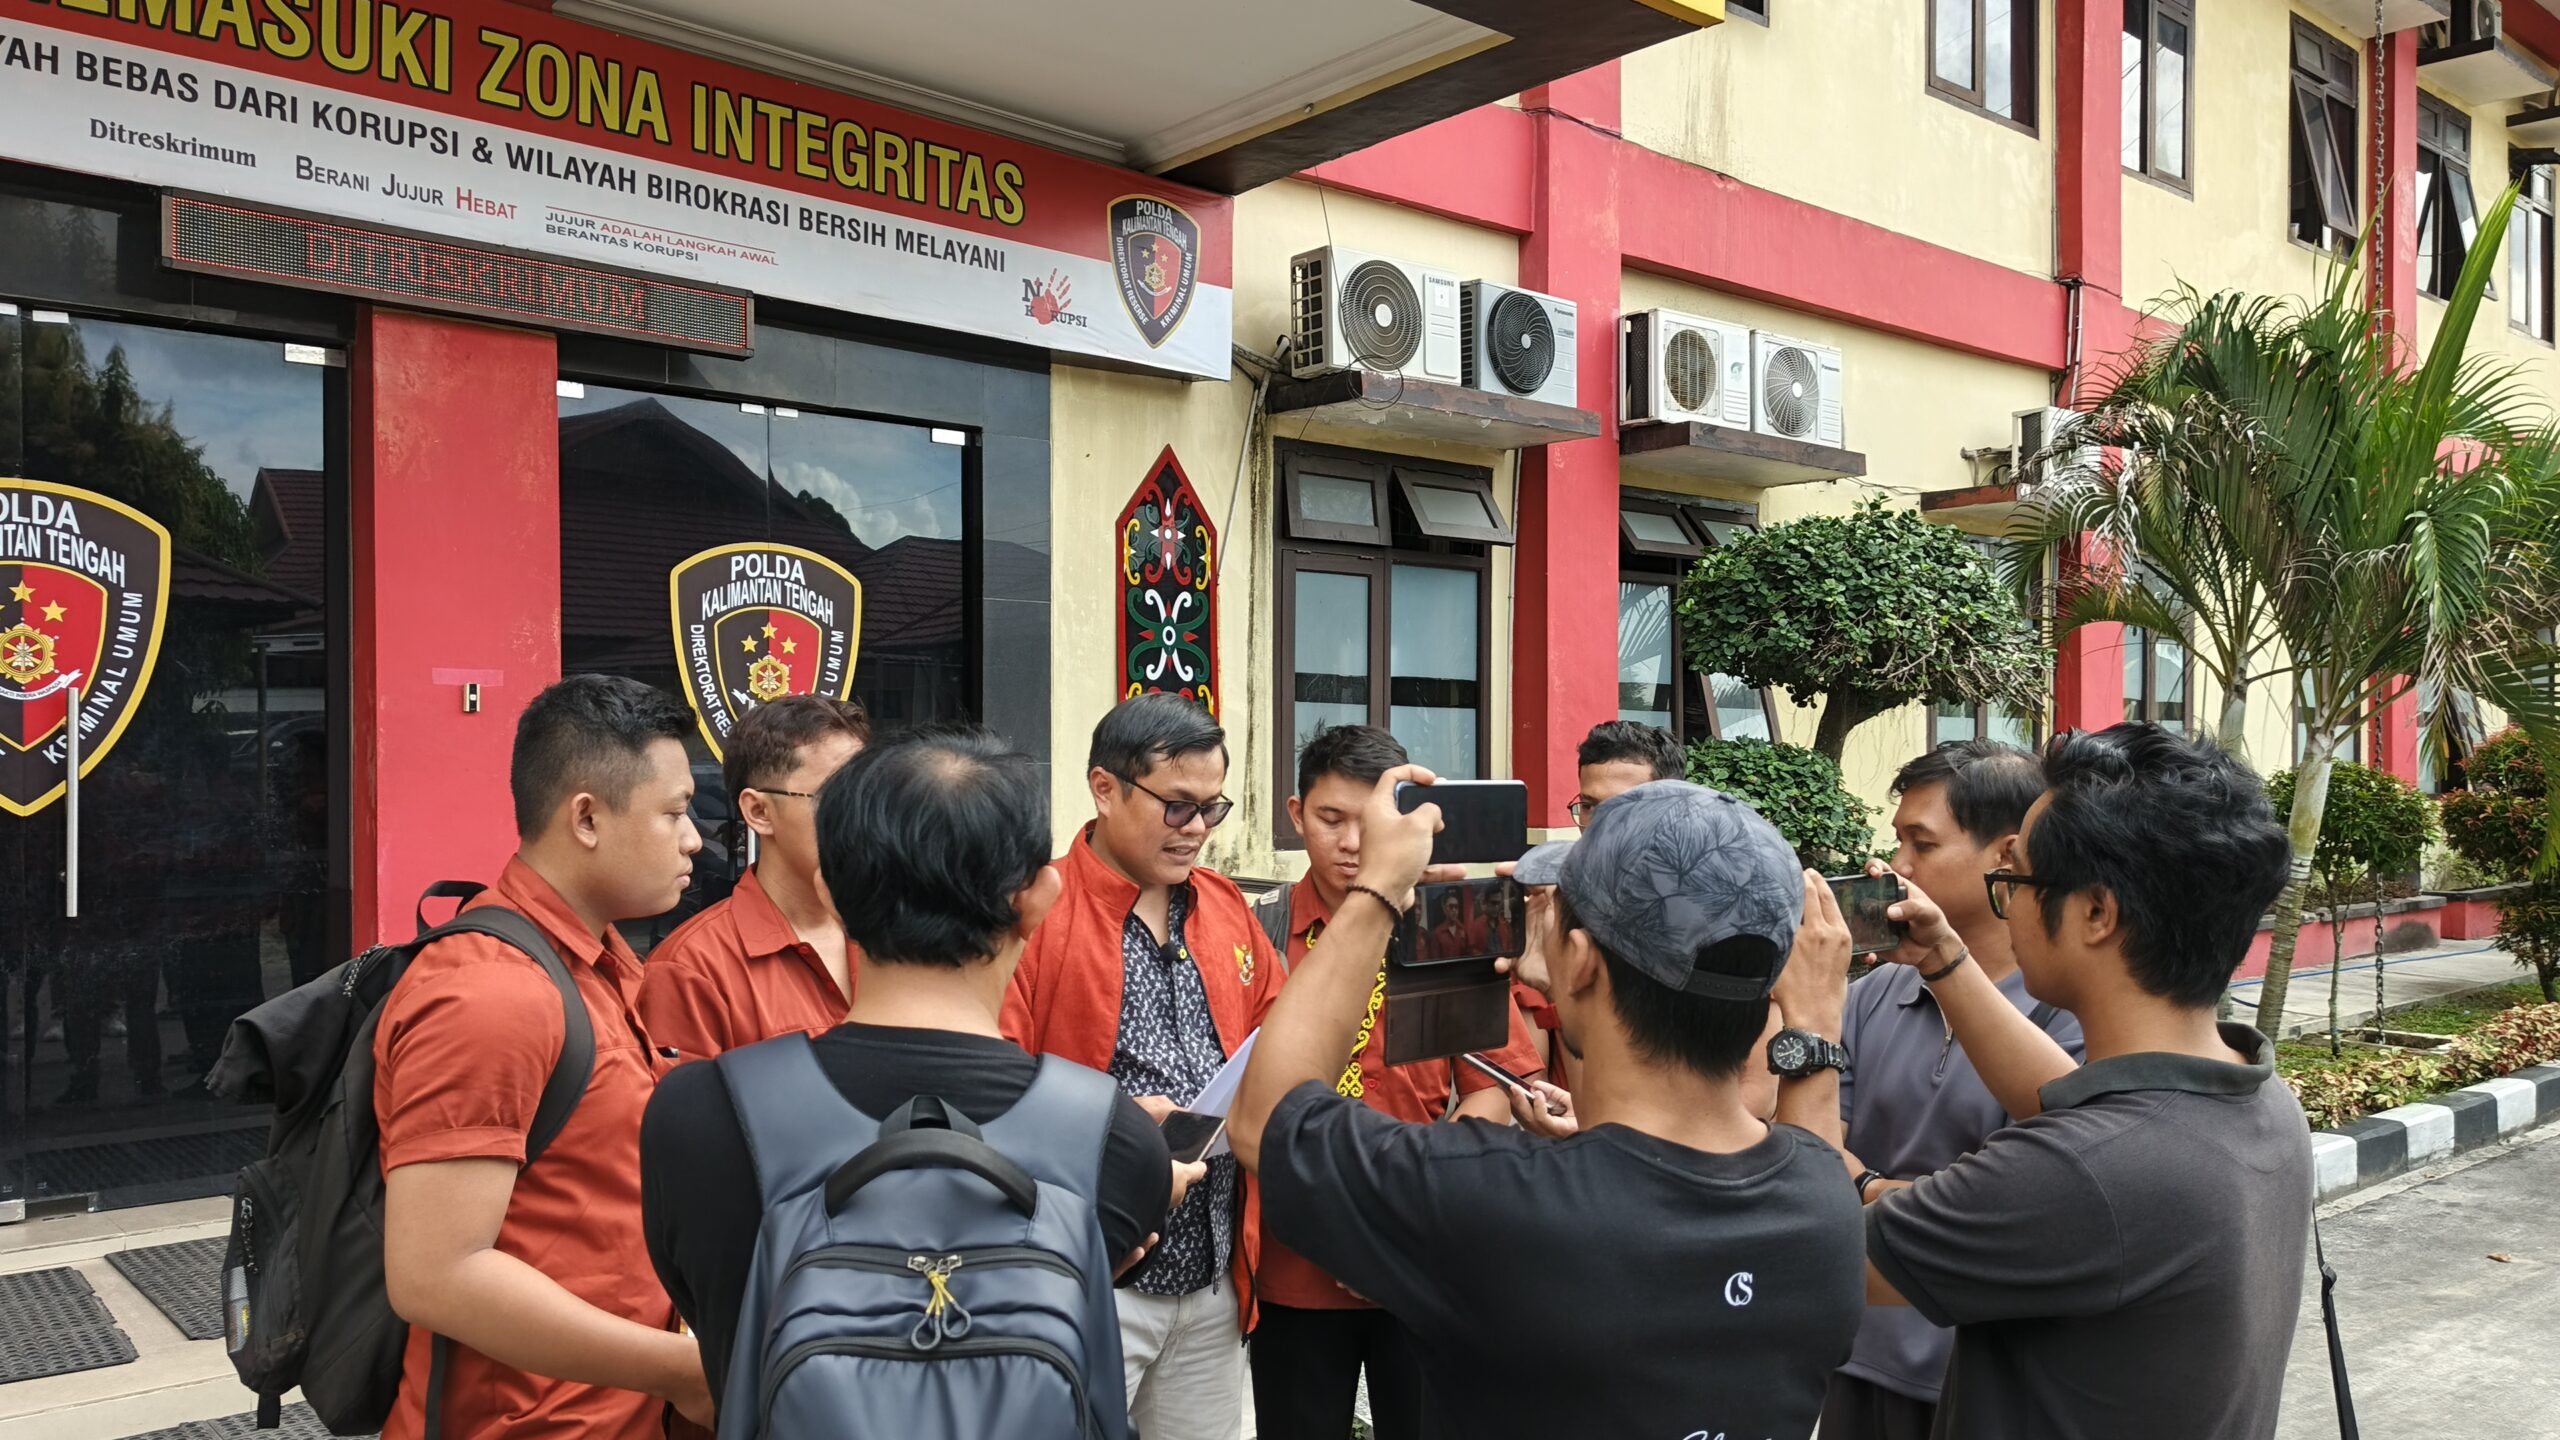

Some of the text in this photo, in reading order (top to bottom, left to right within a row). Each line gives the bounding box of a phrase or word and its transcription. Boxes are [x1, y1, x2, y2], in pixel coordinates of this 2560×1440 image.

[0, 34, 1005, 272] AH BEBAS DARI KORUPSI & WILAYAH BIROKRASI BERSIH MELAYANI
[90, 118, 257, 168] Ditreskrimum
[477, 27, 672, 145] ZONA
[691, 81, 1026, 226] INTEGRITAS
[296, 155, 518, 220] BERANI JUJUR HEBAT
[1136, 200, 1173, 224] POLDA
[545, 212, 779, 266] JUJUR ADALAH LANGKAH AWAL
[545, 224, 699, 262] BERANTAS KORUPSI
[1122, 216, 1187, 251] KALIMANTAN TENGAH
[306, 232, 645, 321] DITRESKRIMUM
[1116, 237, 1132, 289] DIREKTORAT
[1160, 252, 1193, 328] KRIMINAL UMUM
[46, 528, 125, 588] TENGAH
[731, 554, 806, 585] POLDA
[113, 592, 144, 659] UMUM
[702, 578, 833, 627] KALIMANTAN TENGAH
[690, 624, 722, 709] DIREKTORAT
[824, 630, 844, 683] UMUM
